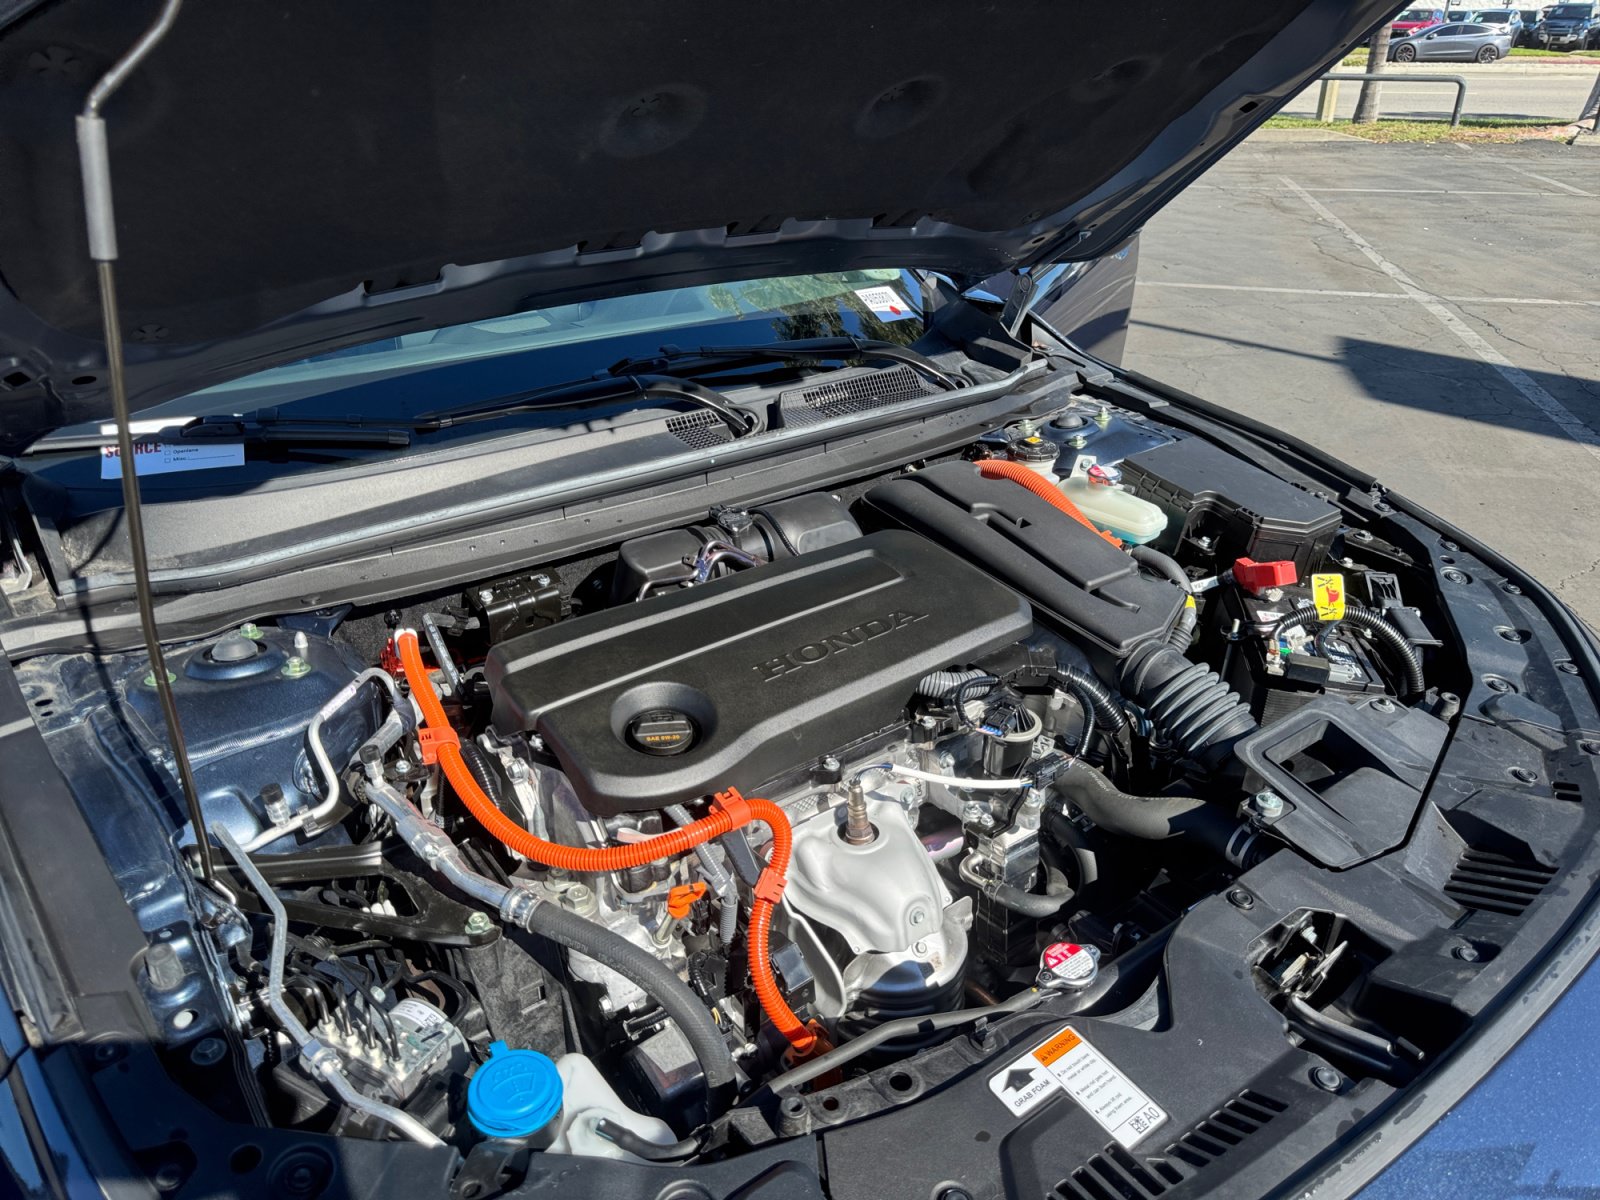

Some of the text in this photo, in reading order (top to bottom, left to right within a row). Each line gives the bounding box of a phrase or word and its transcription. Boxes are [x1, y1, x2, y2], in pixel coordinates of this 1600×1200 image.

[105, 443, 161, 458] SORCE
[752, 610, 930, 682] HONDA
[1045, 1033, 1076, 1057] WARNING
[1014, 1079, 1050, 1107] GRAB FOAM
